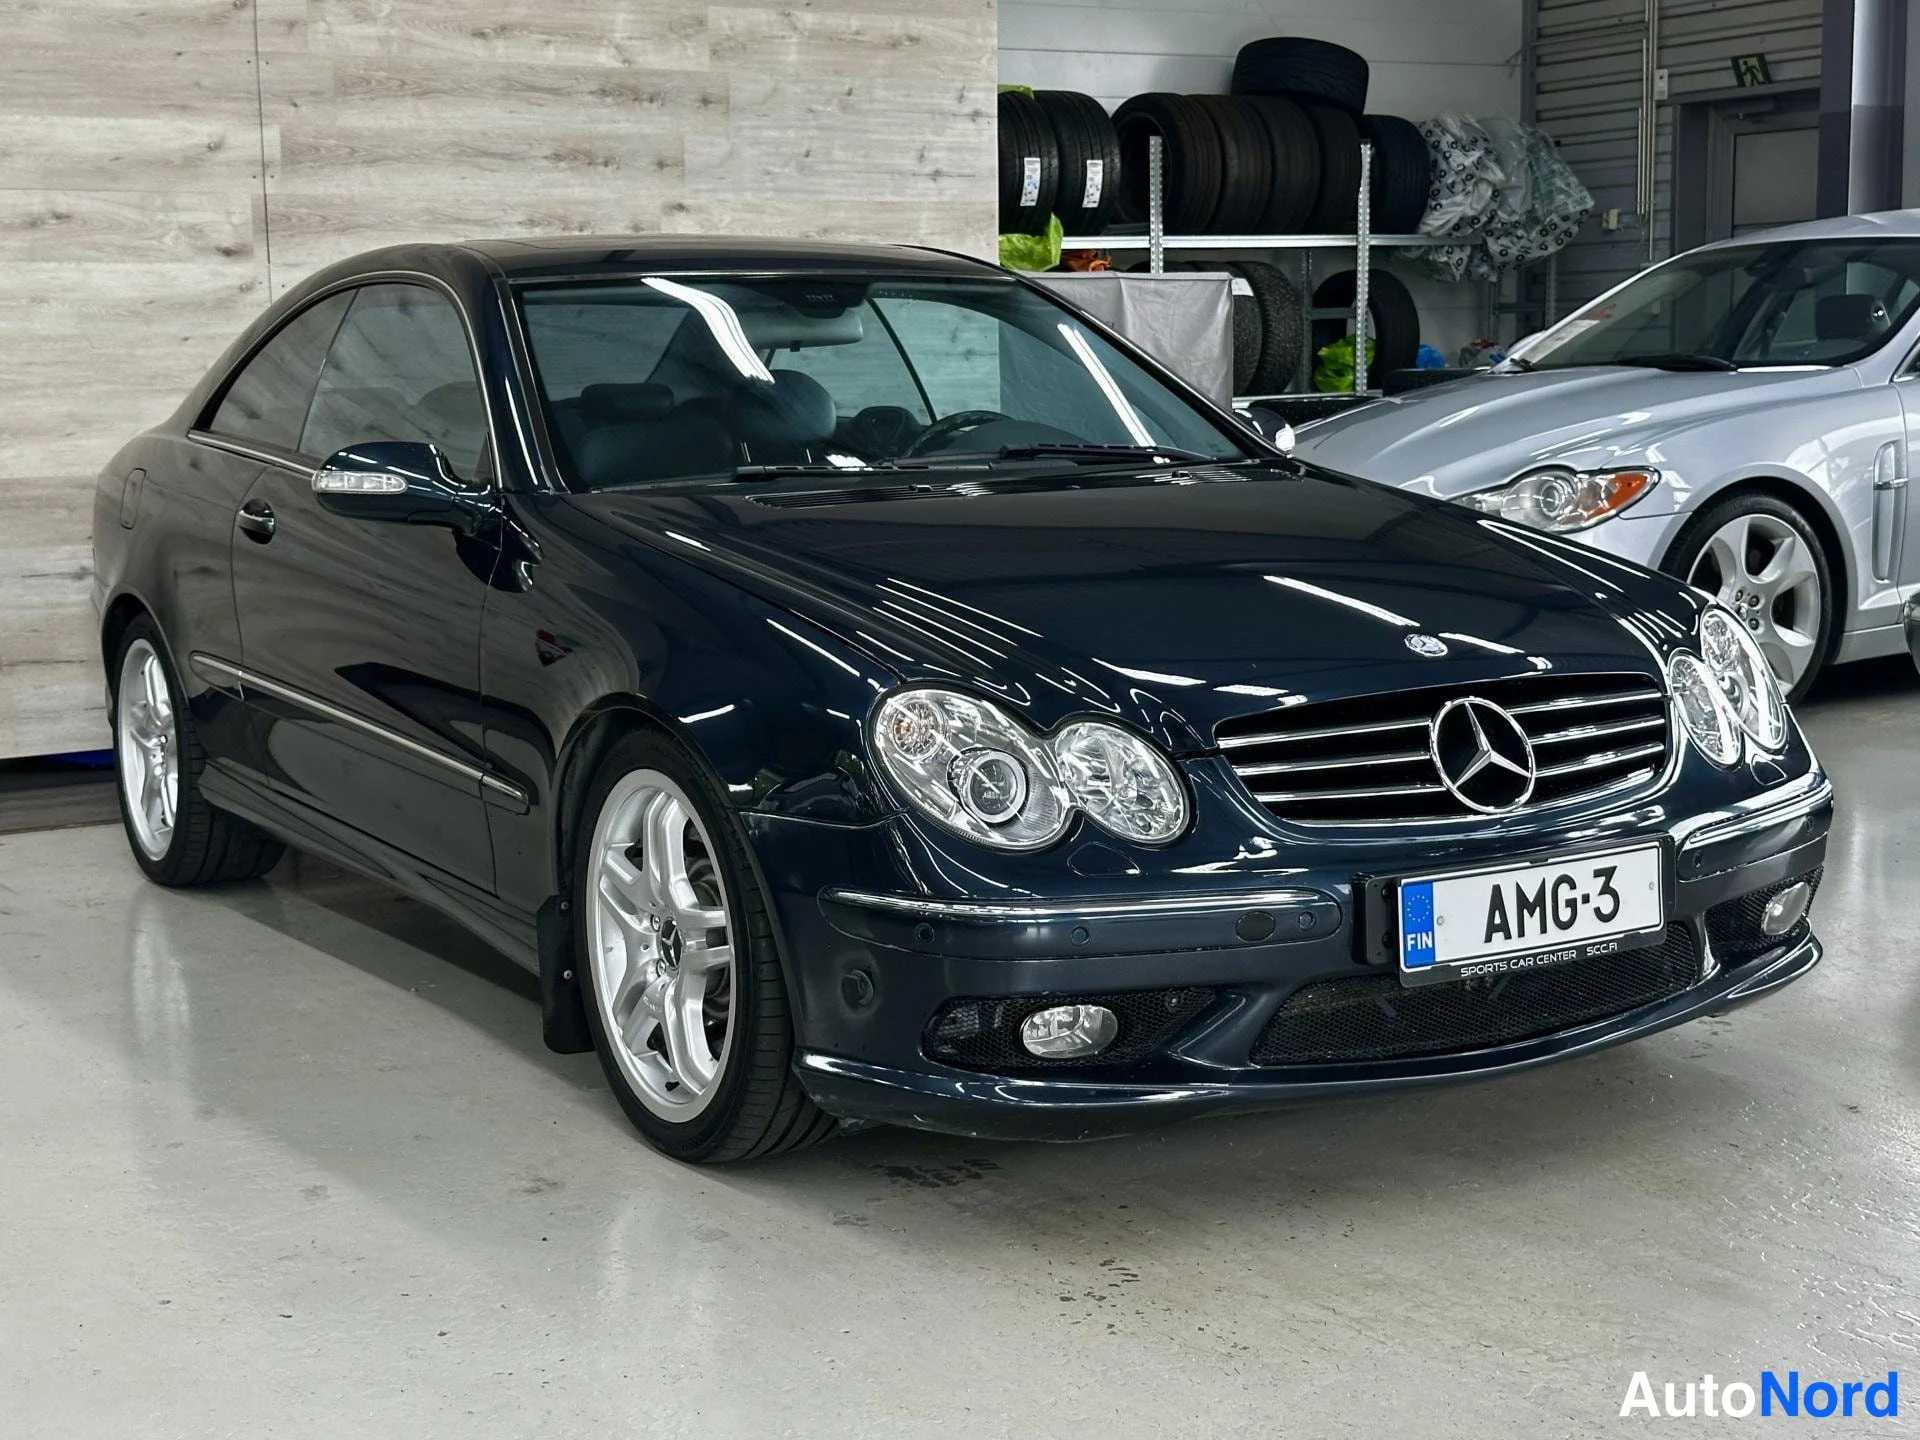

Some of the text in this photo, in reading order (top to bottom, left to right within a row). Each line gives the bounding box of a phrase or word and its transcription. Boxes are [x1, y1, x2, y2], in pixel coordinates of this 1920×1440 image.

[1484, 866, 1620, 943] AMG-3
[1407, 931, 1433, 951] FIN
[1460, 961, 1507, 977] SPORTS
[1510, 956, 1534, 969] CAR
[1536, 950, 1577, 964] CENTER
